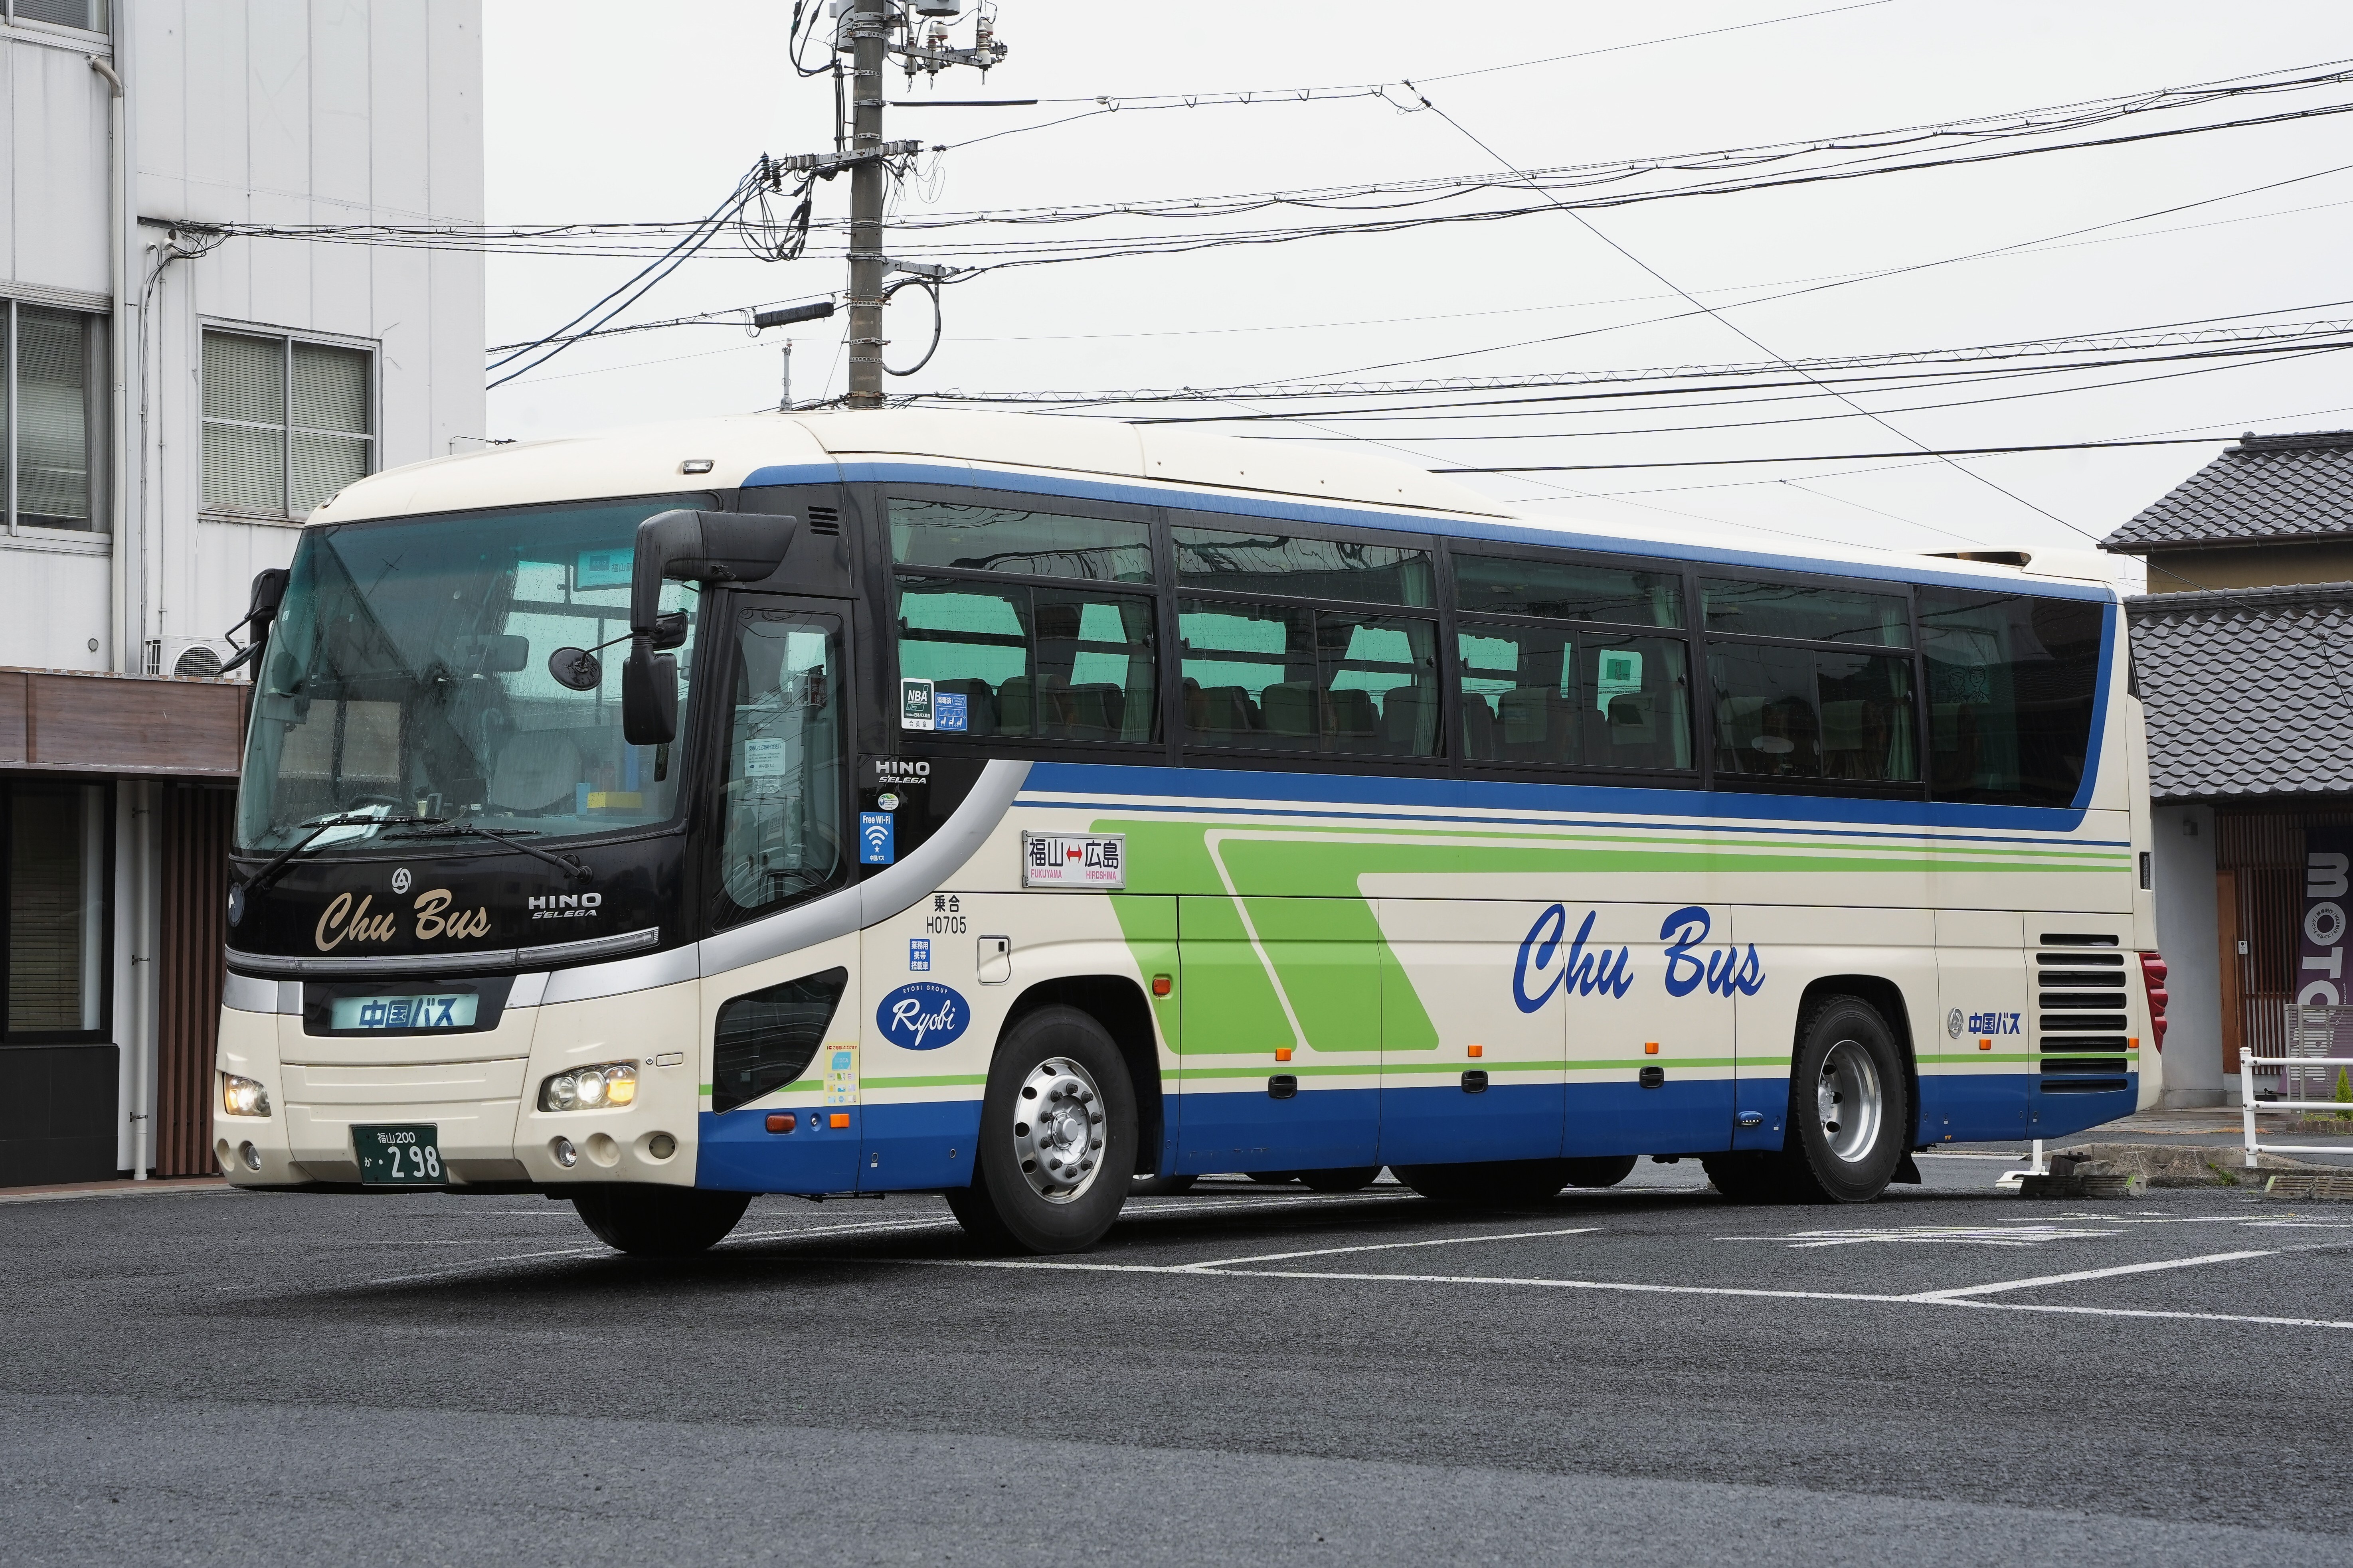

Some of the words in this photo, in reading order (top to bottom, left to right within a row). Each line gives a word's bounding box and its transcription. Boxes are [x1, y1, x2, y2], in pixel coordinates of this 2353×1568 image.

[908, 690, 927, 702] NBA
[937, 696, 952, 705] 消毒済
[876, 761, 930, 776] HINO
[863, 815, 875, 824] Free
[876, 815, 890, 824] Wi-Fi
[1029, 838, 1064, 867] 福山
[1084, 840, 1119, 869] 広島
[1031, 869, 1062, 879] FUKUYAMA
[1086, 871, 1116, 880] HIROSHIMA
[529, 893, 601, 910] HINO
[934, 895, 960, 912] 乗合
[315, 892, 396, 952] Chu
[414, 889, 491, 940] Bus
[927, 916, 966, 934] H0705
[911, 940, 928, 950] 業務用
[914, 951, 926, 960] 携帯
[1513, 903, 1634, 1014] Chu
[1660, 906, 1766, 998] Bus
[911, 961, 929, 970] 搭載車
[903, 985, 922, 994] RYOBI
[926, 985, 948, 994] GROUP
[359, 998, 457, 1028] 中国バス
[892, 998, 956, 1046] Ryobi
[1968, 1012, 2021, 1034] 中国バス
[364, 1157, 372, 1167] か
